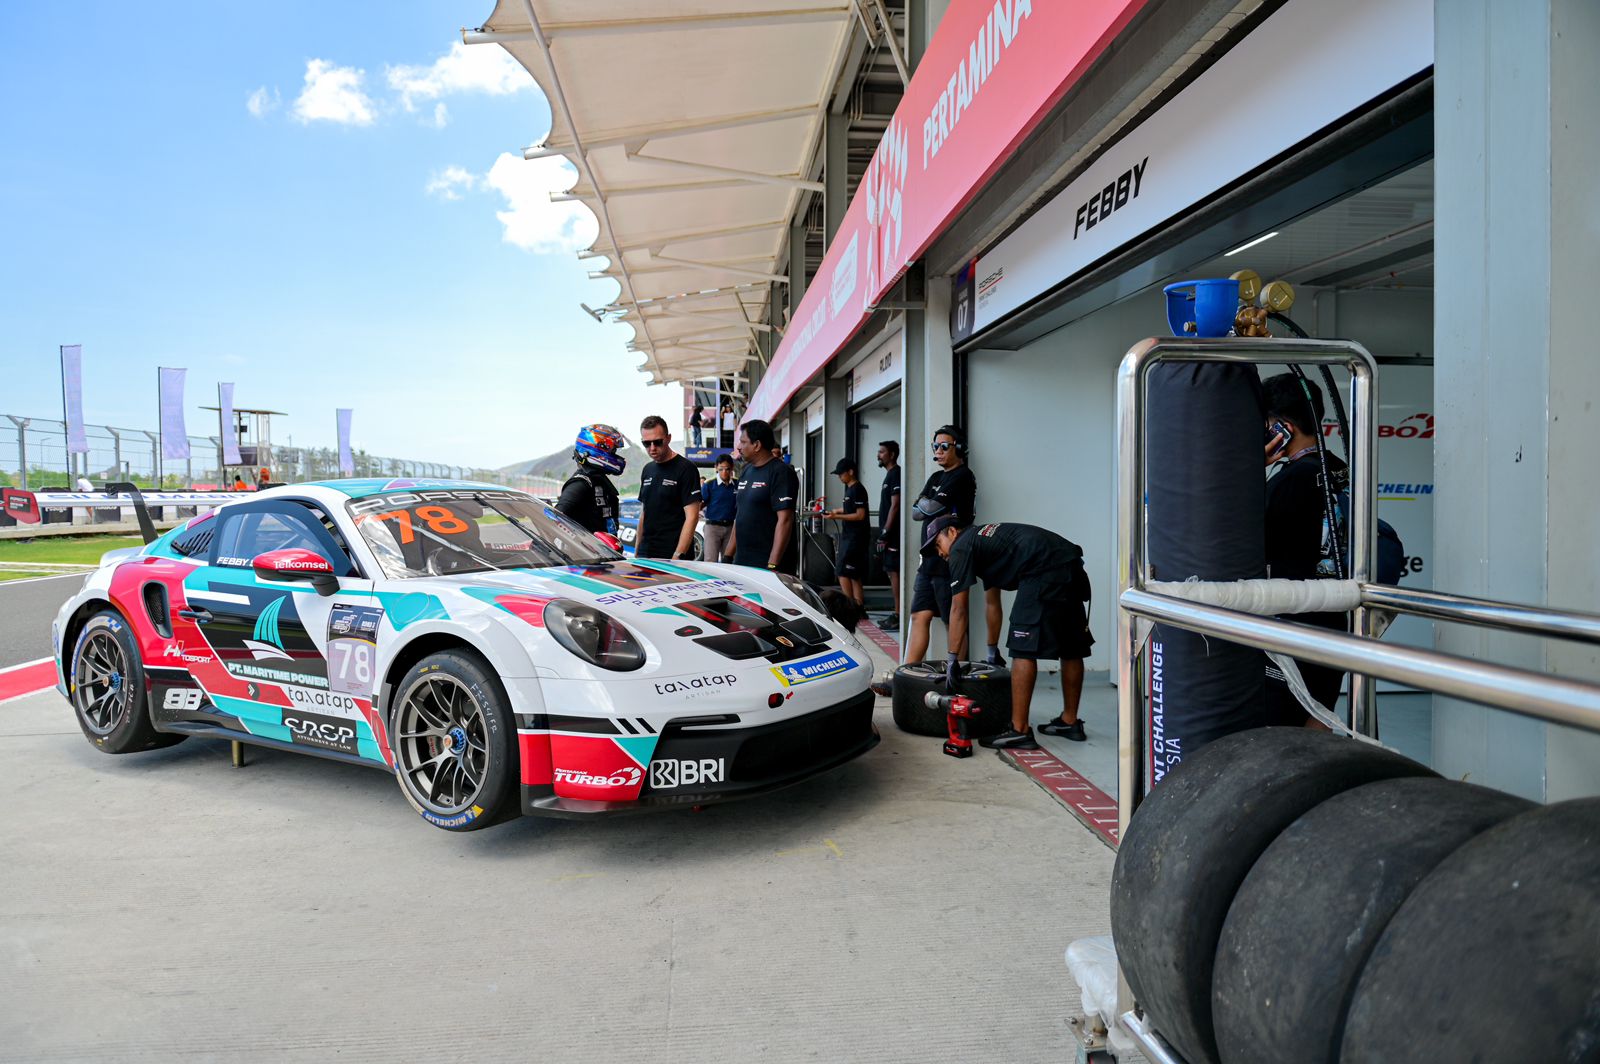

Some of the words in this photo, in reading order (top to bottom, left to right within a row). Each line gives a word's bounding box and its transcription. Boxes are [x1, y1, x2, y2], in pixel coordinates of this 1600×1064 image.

[923, 0, 1032, 171] PERTAMINA
[1073, 156, 1149, 241] FEBBY
[957, 299, 969, 332] 07
[354, 505, 470, 545] 78
[216, 556, 250, 566] FEBBY
[273, 560, 329, 570] Telkomsel
[596, 590, 658, 605] SILLO
[244, 665, 290, 681] MARITIME
[291, 674, 329, 688] POWER
[334, 642, 371, 683] 78
[801, 656, 849, 676] MICHELIN
[1152, 641, 1164, 754] CHALLENGE
[680, 758, 725, 785] BRI
